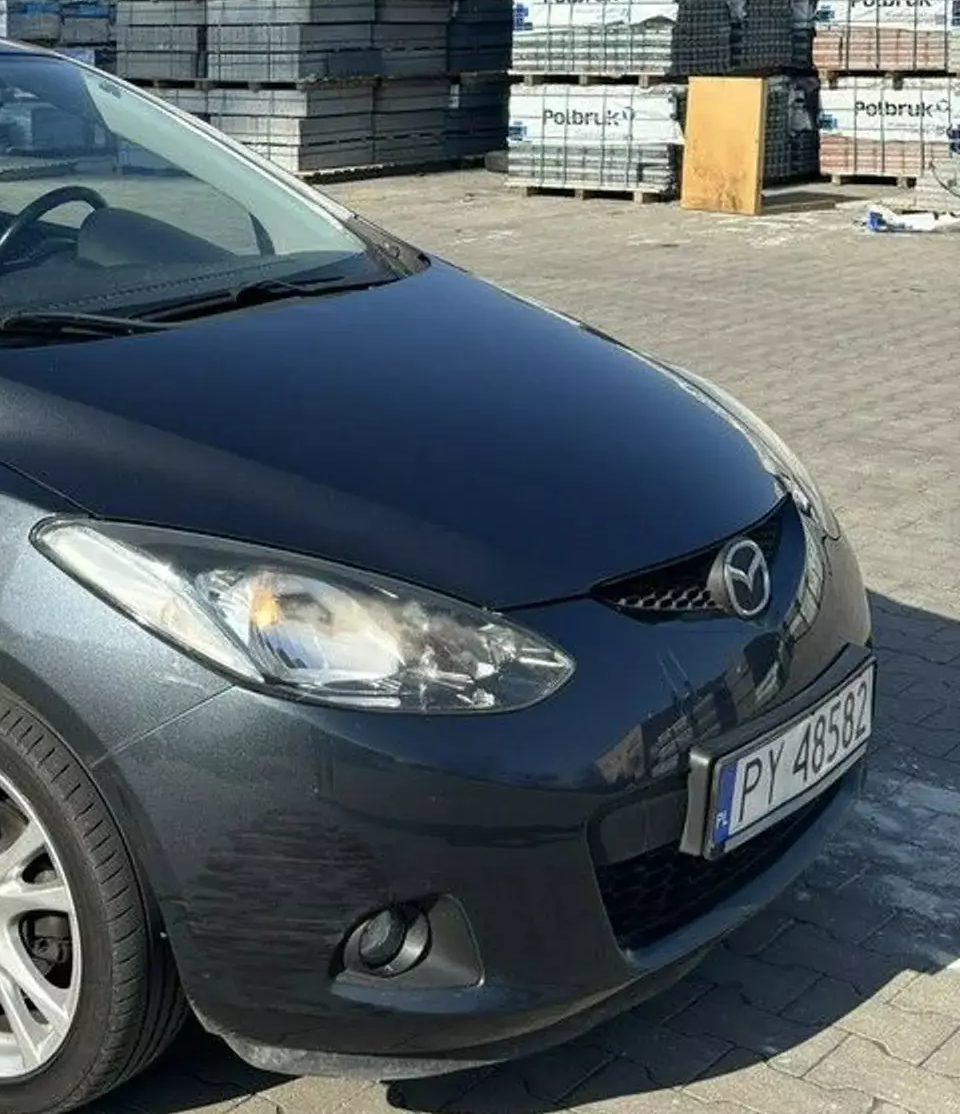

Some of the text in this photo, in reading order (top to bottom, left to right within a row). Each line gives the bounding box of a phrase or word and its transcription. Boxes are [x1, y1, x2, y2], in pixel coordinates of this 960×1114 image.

[543, 108, 620, 127] Polbruk
[855, 100, 934, 118] Polbruk
[738, 681, 868, 823] PY 48582
